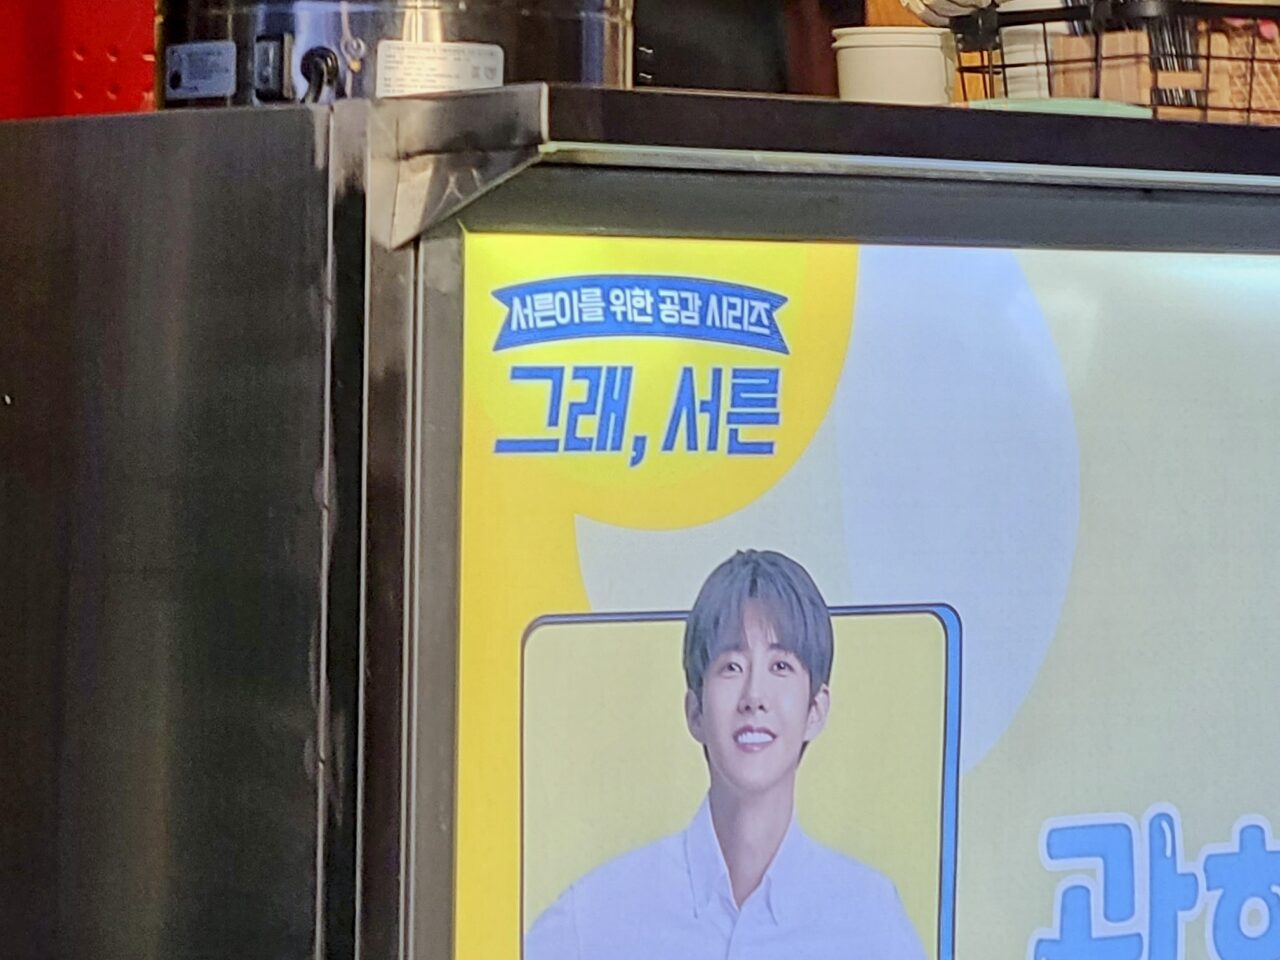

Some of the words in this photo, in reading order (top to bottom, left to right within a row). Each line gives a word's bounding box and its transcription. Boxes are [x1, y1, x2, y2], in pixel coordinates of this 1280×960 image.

[510, 286, 605, 332] 서른이를
[609, 286, 654, 323] 위한
[658, 289, 702, 326] 공감
[705, 293, 772, 335] 시리즈
[494, 365, 648, 467] 그래,
[662, 366, 781, 455] 서른
